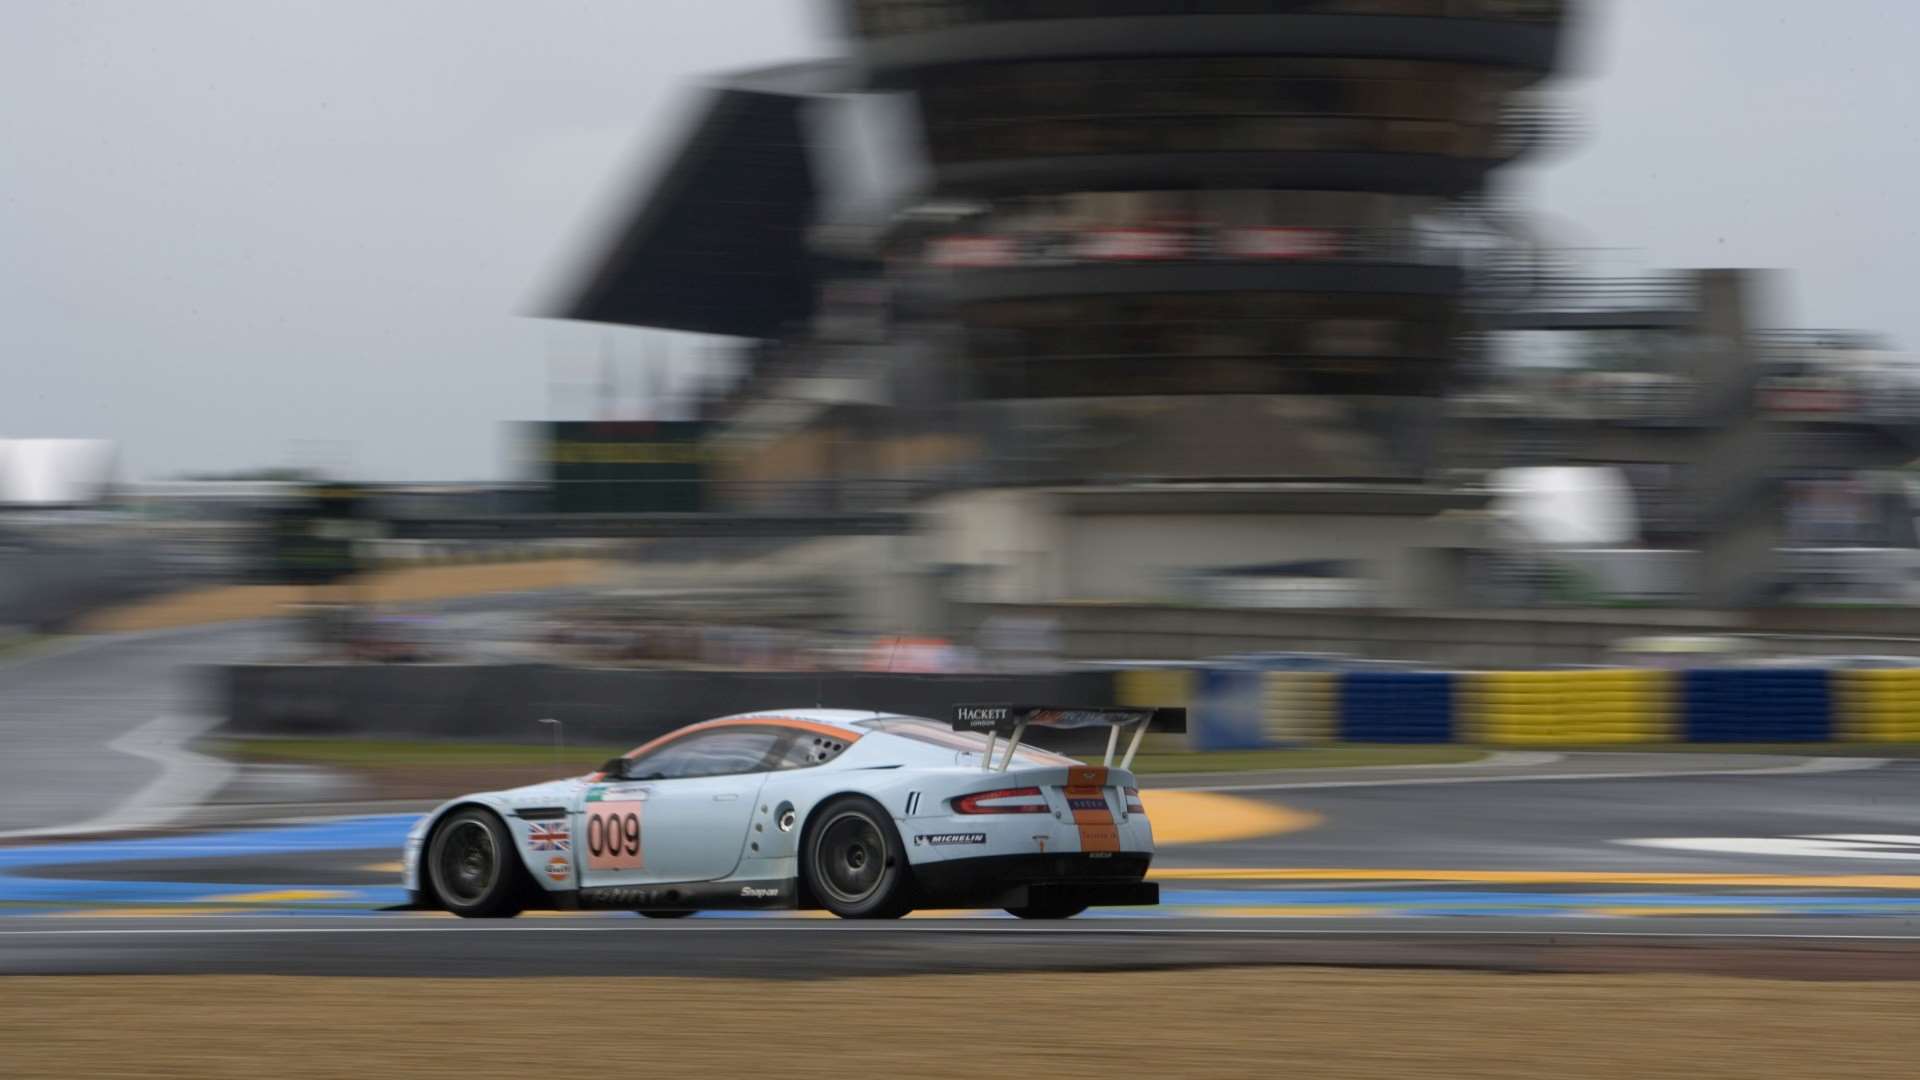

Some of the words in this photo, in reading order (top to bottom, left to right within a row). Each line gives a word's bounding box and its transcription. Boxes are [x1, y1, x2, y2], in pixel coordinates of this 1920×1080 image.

[957, 708, 1008, 720] HACKETT
[588, 813, 640, 857] 009
[931, 834, 984, 844] MICHELIN
